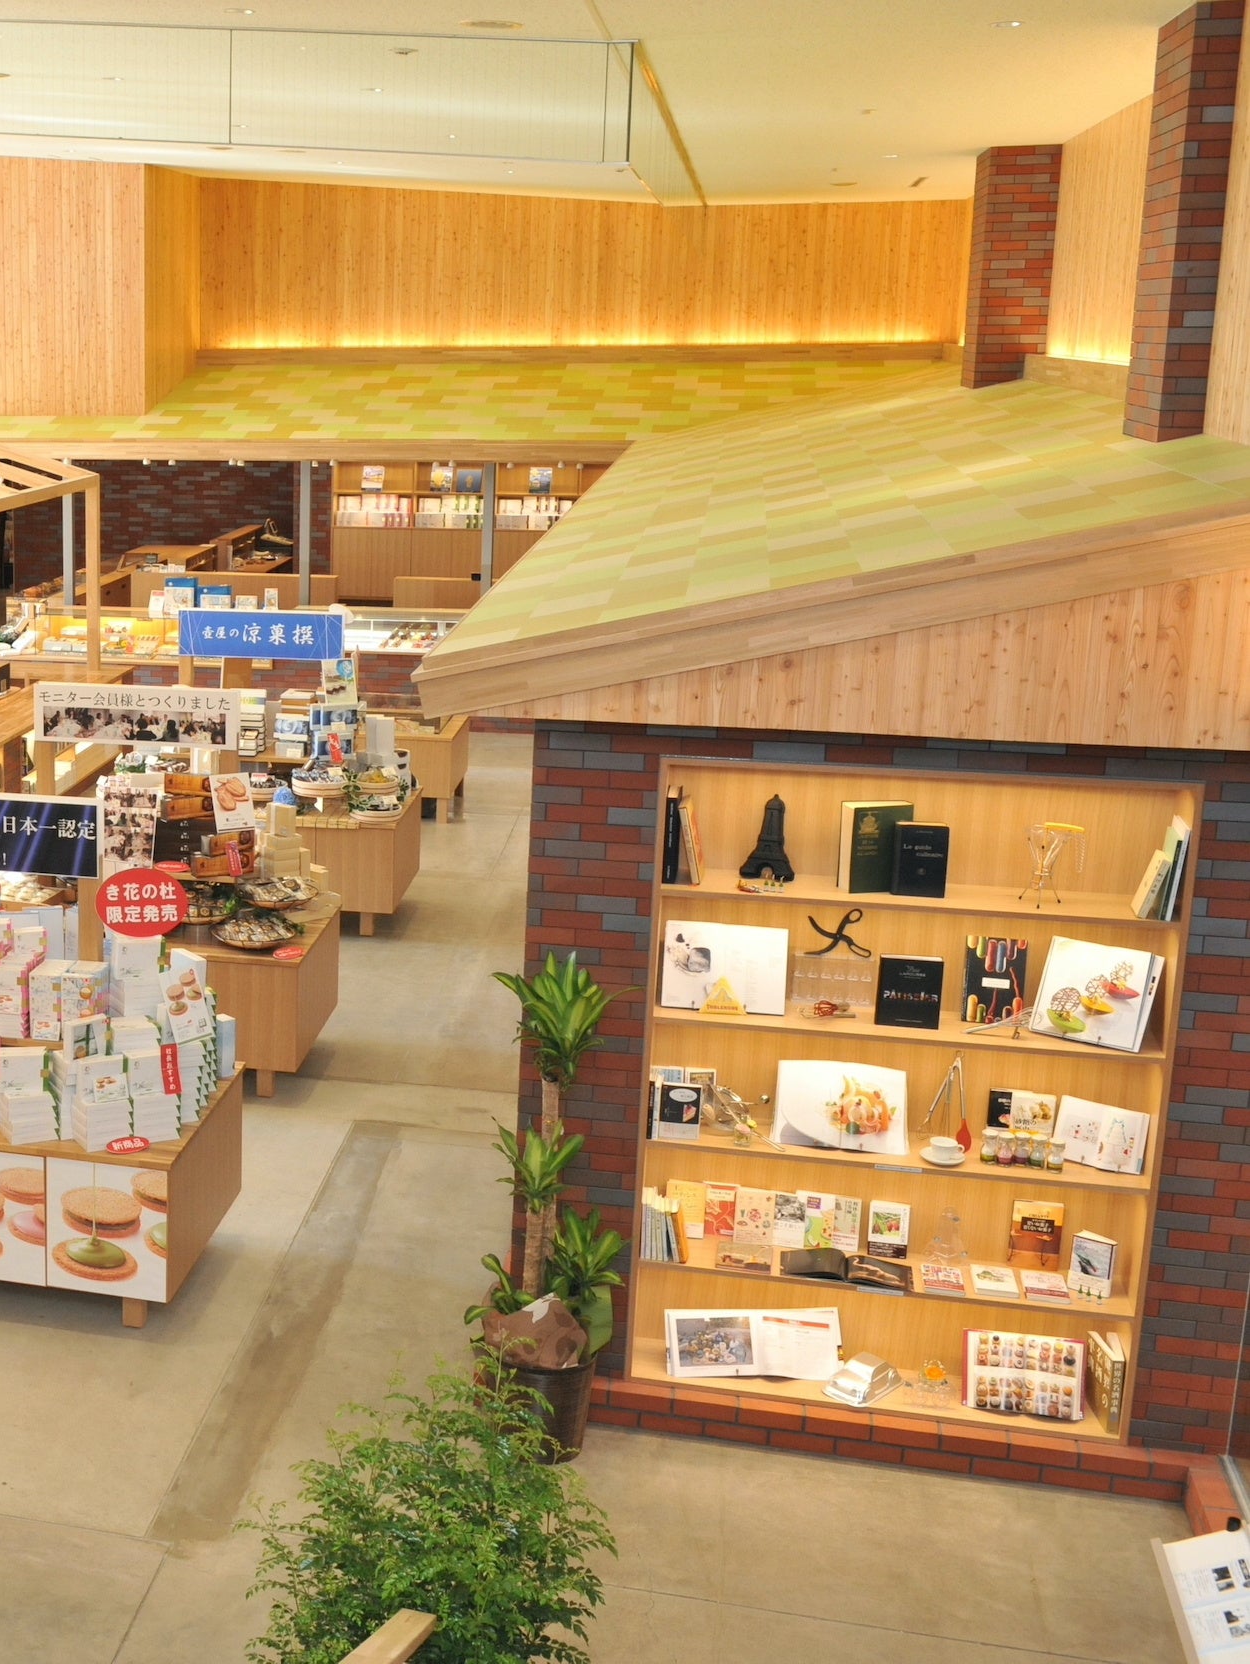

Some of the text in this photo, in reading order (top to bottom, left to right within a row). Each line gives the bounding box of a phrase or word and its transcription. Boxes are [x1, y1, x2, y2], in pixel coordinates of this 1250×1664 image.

[38, 691, 231, 711] モニター会員様とつくりました
[2, 816, 97, 841] 日本一認定
[106, 882, 177, 901] き花の杜
[106, 904, 179, 924] 限定発売
